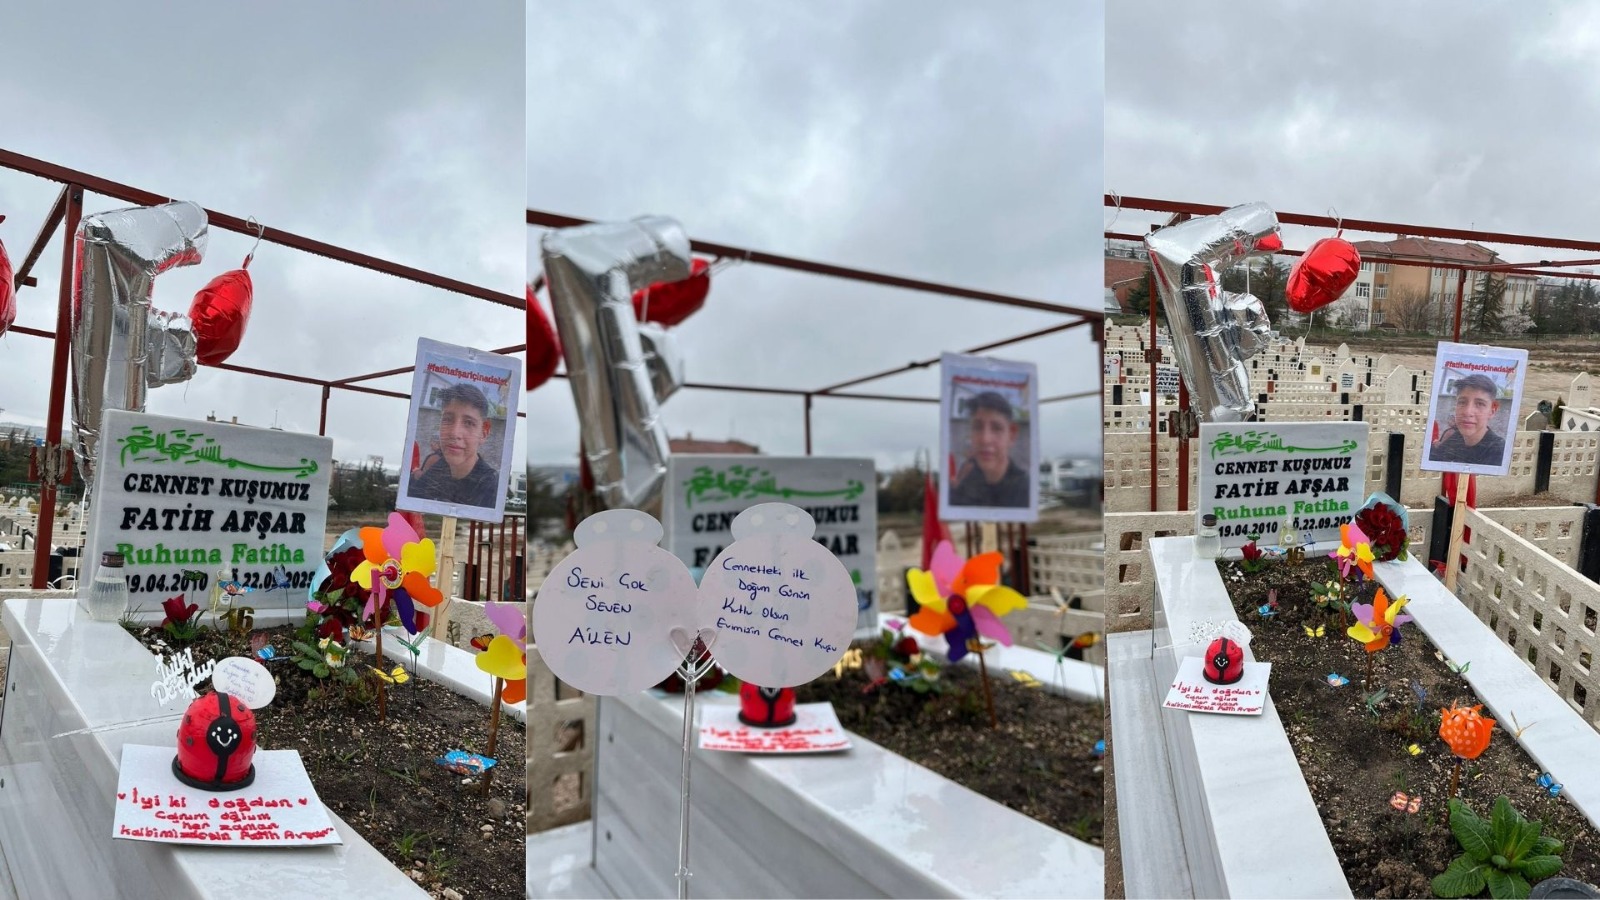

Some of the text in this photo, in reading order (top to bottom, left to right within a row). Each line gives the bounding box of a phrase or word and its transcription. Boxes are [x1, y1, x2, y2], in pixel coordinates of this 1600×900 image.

[1214, 456, 1352, 475] CENNET KUŞUMUZ
[123, 473, 310, 504] CENNET KUŞUMUZ
[1214, 477, 1349, 499] FATİH AFŞAR
[1213, 498, 1350, 521] Ruhuna Fatiha
[120, 503, 306, 540] FATİH AFŞAR
[1218, 521, 1278, 537] 19.04.2010
[115, 543, 305, 565] Ruhuna Fatiha
[722, 557, 810, 580] Cennetteki ilk
[738, 578, 810, 601] Doğum Günün
[722, 597, 753, 615] Kutlu
[768, 627, 803, 646] Cennet
